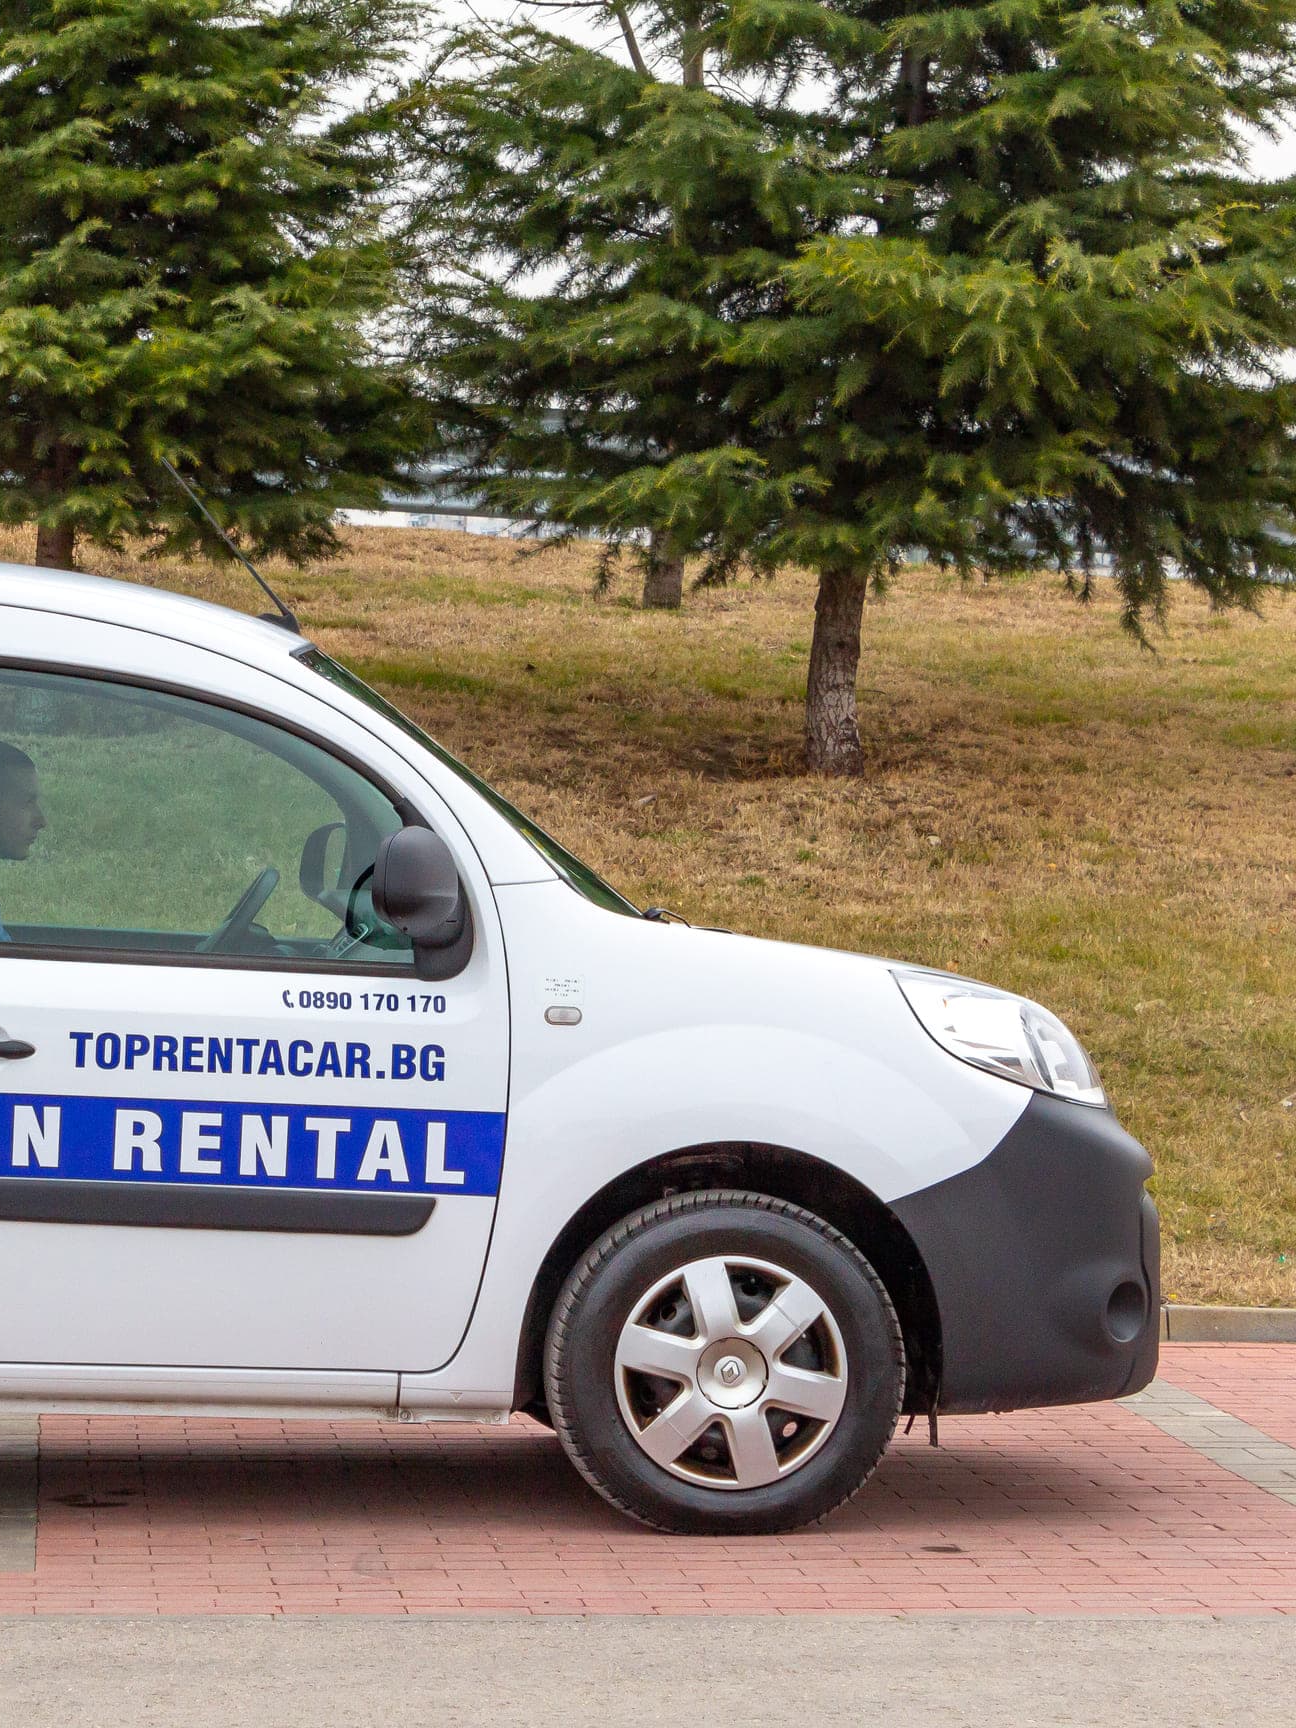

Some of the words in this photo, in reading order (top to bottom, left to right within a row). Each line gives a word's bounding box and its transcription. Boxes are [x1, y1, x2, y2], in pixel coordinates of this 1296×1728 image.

[299, 990, 353, 1010] 0890
[360, 993, 399, 1012] 170
[407, 994, 447, 1014] 170
[69, 1031, 446, 1082] TOPRENTACAR.BG
[112, 1109, 466, 1185] RENTAL
